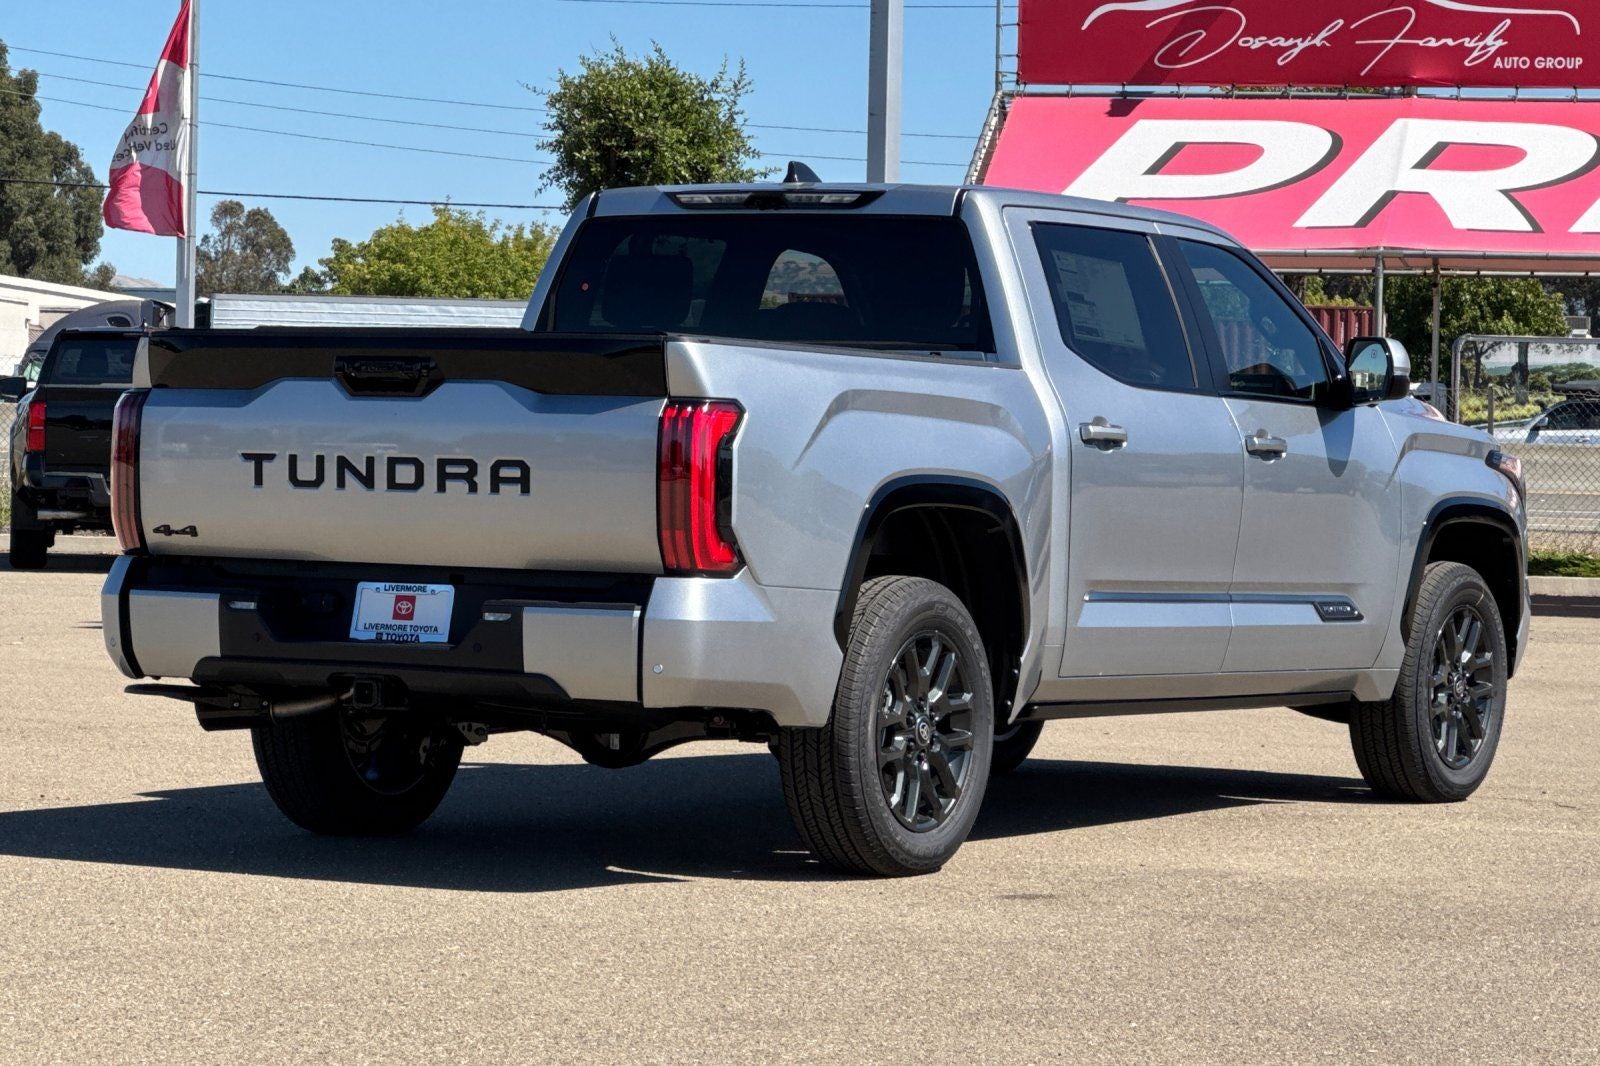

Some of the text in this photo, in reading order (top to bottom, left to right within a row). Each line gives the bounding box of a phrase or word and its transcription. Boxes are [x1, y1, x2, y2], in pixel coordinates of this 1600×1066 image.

[1350, 6, 1511, 76] Family
[1493, 56, 1583, 69] AUTO GROUP
[1060, 117, 1600, 234] PR
[240, 452, 532, 495] TUNDRA
[383, 583, 428, 593] LIVERMORE
[363, 623, 439, 633] LIVERMORE TOYOTA
[385, 632, 420, 643] TOYOTA
